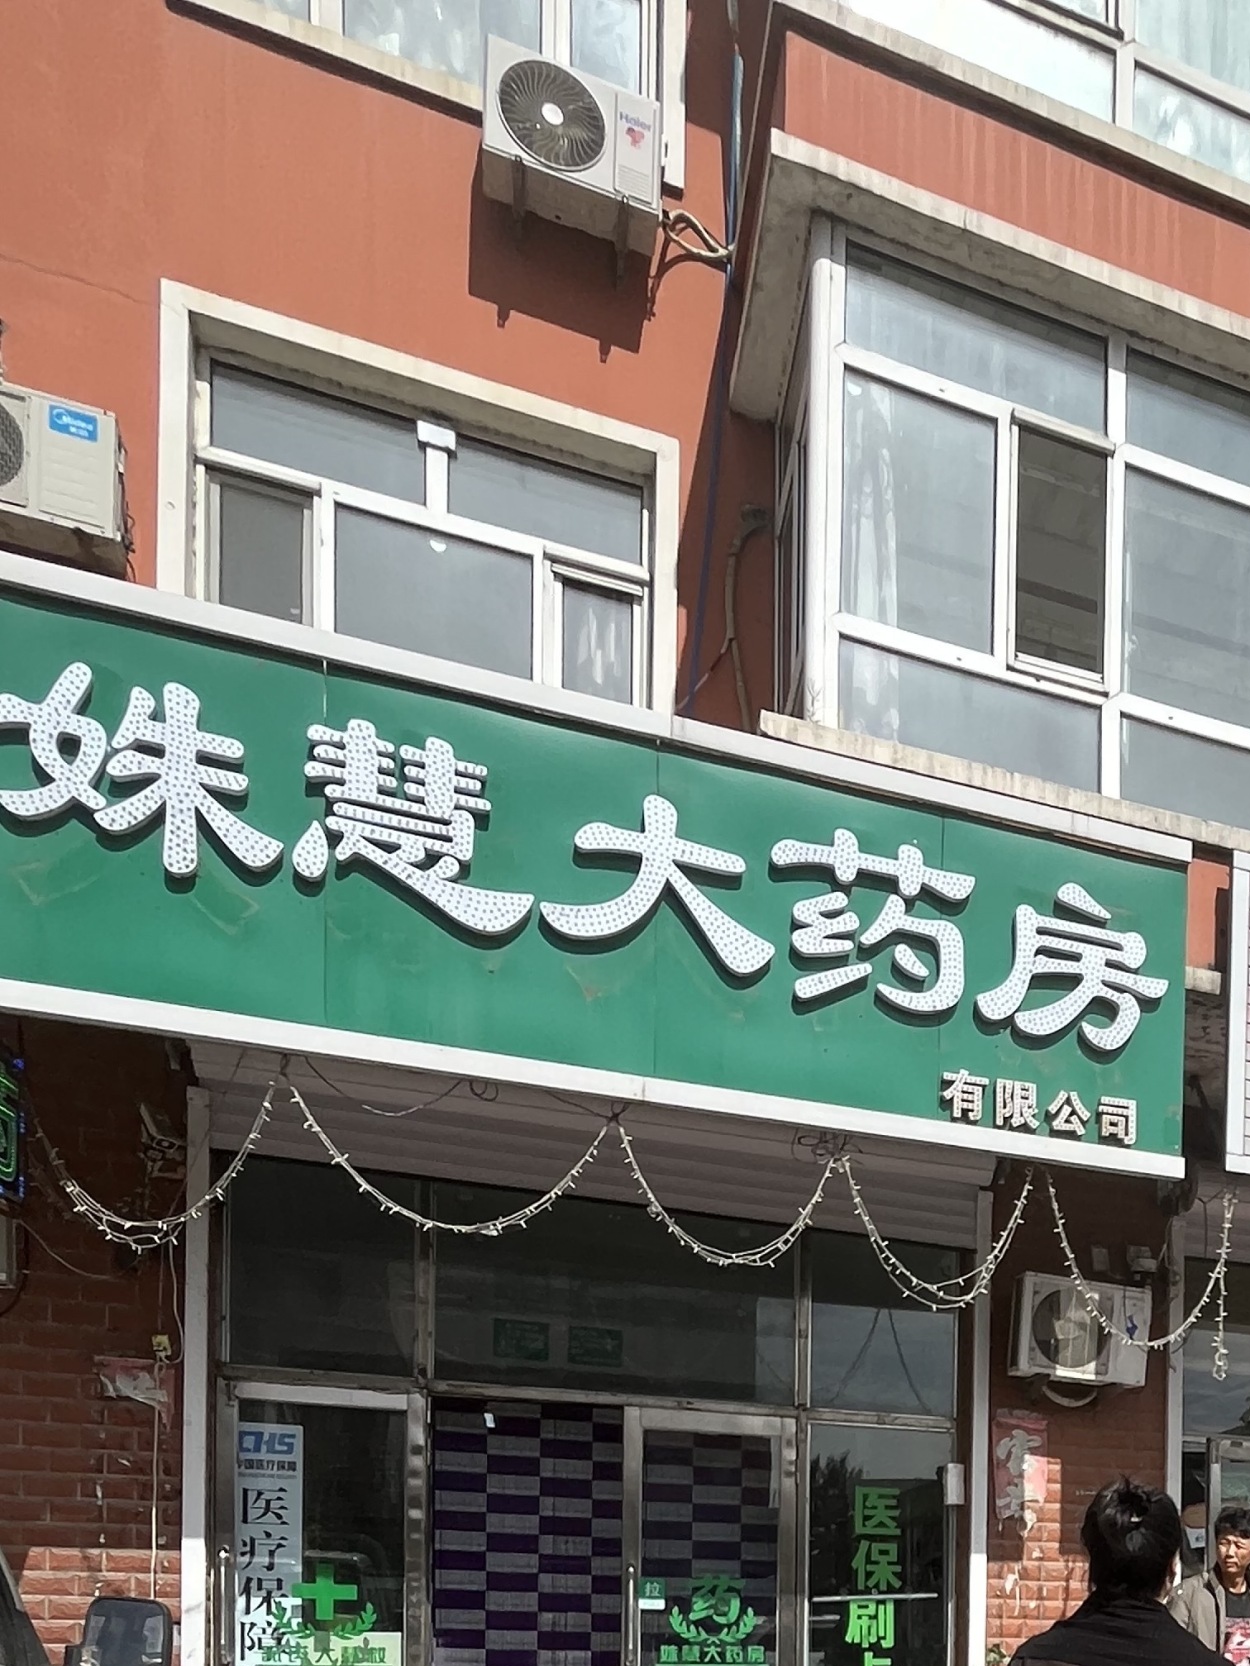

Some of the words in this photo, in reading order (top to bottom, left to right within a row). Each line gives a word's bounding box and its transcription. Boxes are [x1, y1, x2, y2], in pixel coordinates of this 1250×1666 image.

[0, 661, 1169, 1052] 姝慧大药房
[941, 1068, 1137, 1145] 有限公司
[644, 1581, 661, 1597] 拉
